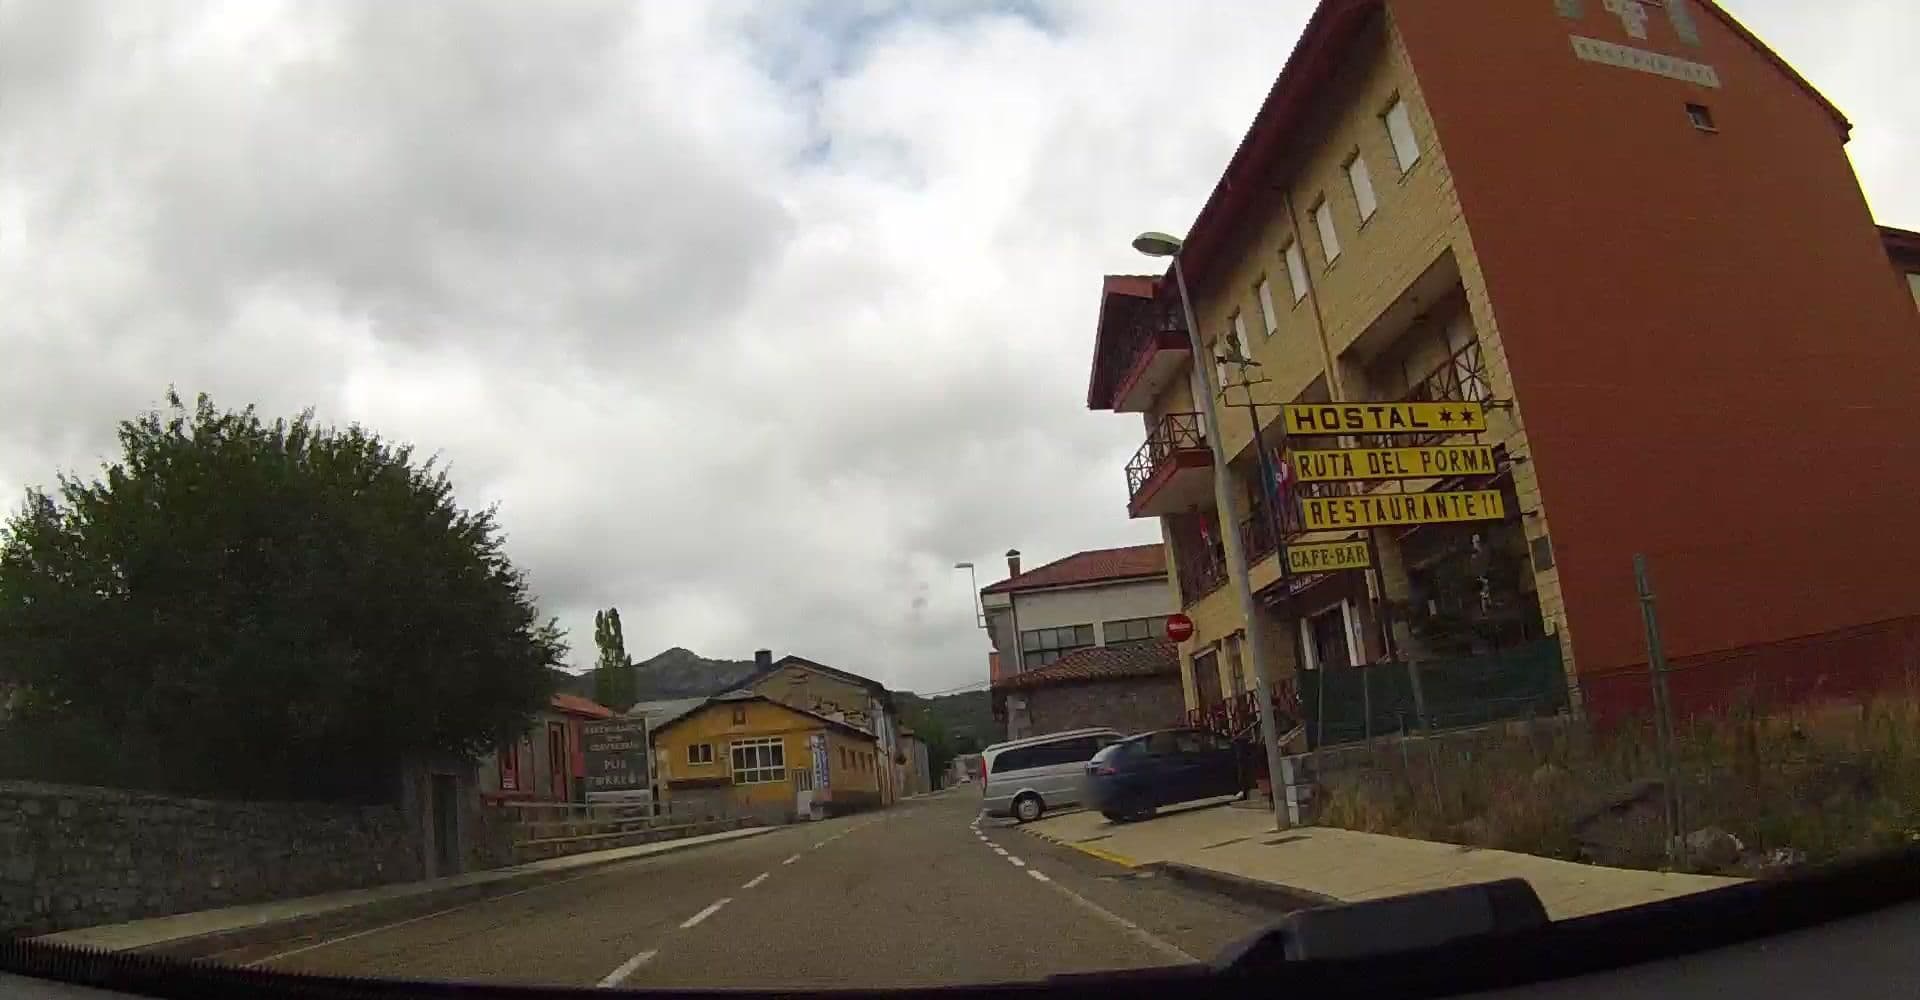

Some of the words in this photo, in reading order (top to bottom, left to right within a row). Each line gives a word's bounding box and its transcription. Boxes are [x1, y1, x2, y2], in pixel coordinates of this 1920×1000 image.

[1294, 406, 1429, 430] HOSTAL
[1298, 453, 1354, 478] RUTA
[1368, 451, 1409, 475] DEL
[1420, 448, 1492, 473] PORMA
[1310, 495, 1477, 525] RESTAURANTE
